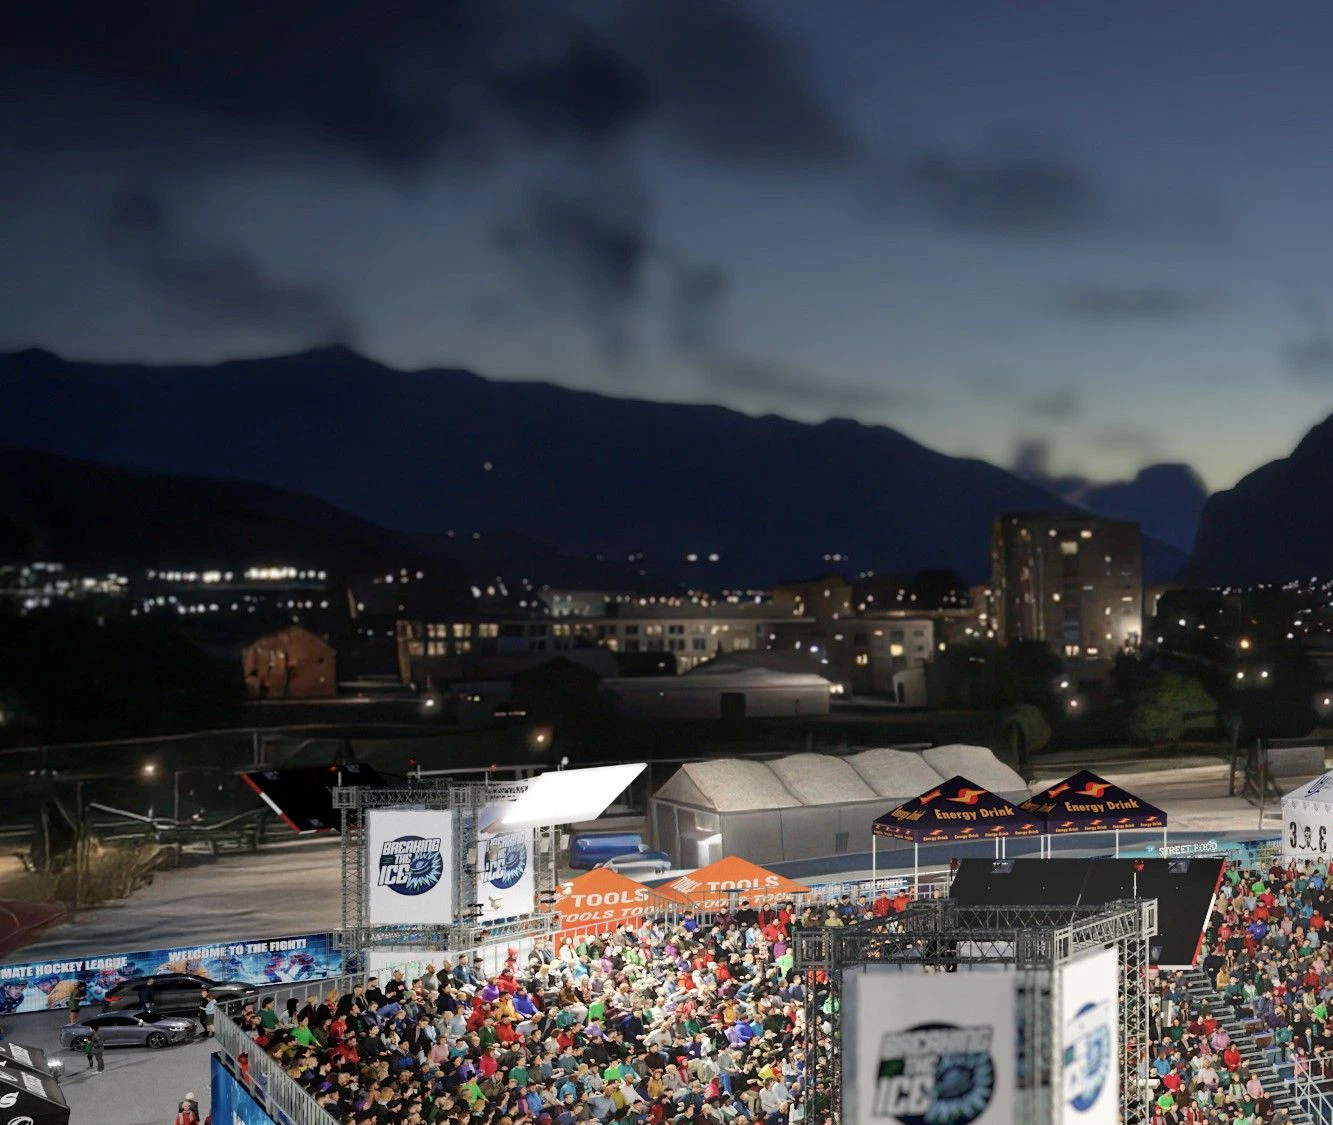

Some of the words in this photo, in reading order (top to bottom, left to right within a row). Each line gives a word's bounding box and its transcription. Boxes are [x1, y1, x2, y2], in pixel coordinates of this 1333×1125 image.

[934, 808, 976, 821] Energy
[980, 806, 1014, 818] Drink
[1065, 801, 1104, 813] Energy
[1107, 799, 1139, 811] Drink
[382, 838, 441, 855] BREAKING
[1159, 843, 1190, 857] STREET
[394, 853, 413, 865] THE
[378, 864, 412, 886] ICE
[706, 876, 779, 892] TOOLS
[574, 888, 650, 908] TOOLS
[560, 910, 615, 923] TOOLS
[169, 947, 227, 962] WELCOME
[229, 944, 244, 957] TO
[246, 942, 267, 955] THE
[269, 938, 308, 952] FIGHT!
[1, 965, 33, 979] MATE
[36, 961, 83, 976] HOCKEY
[85, 956, 128, 971] LEAGUE
